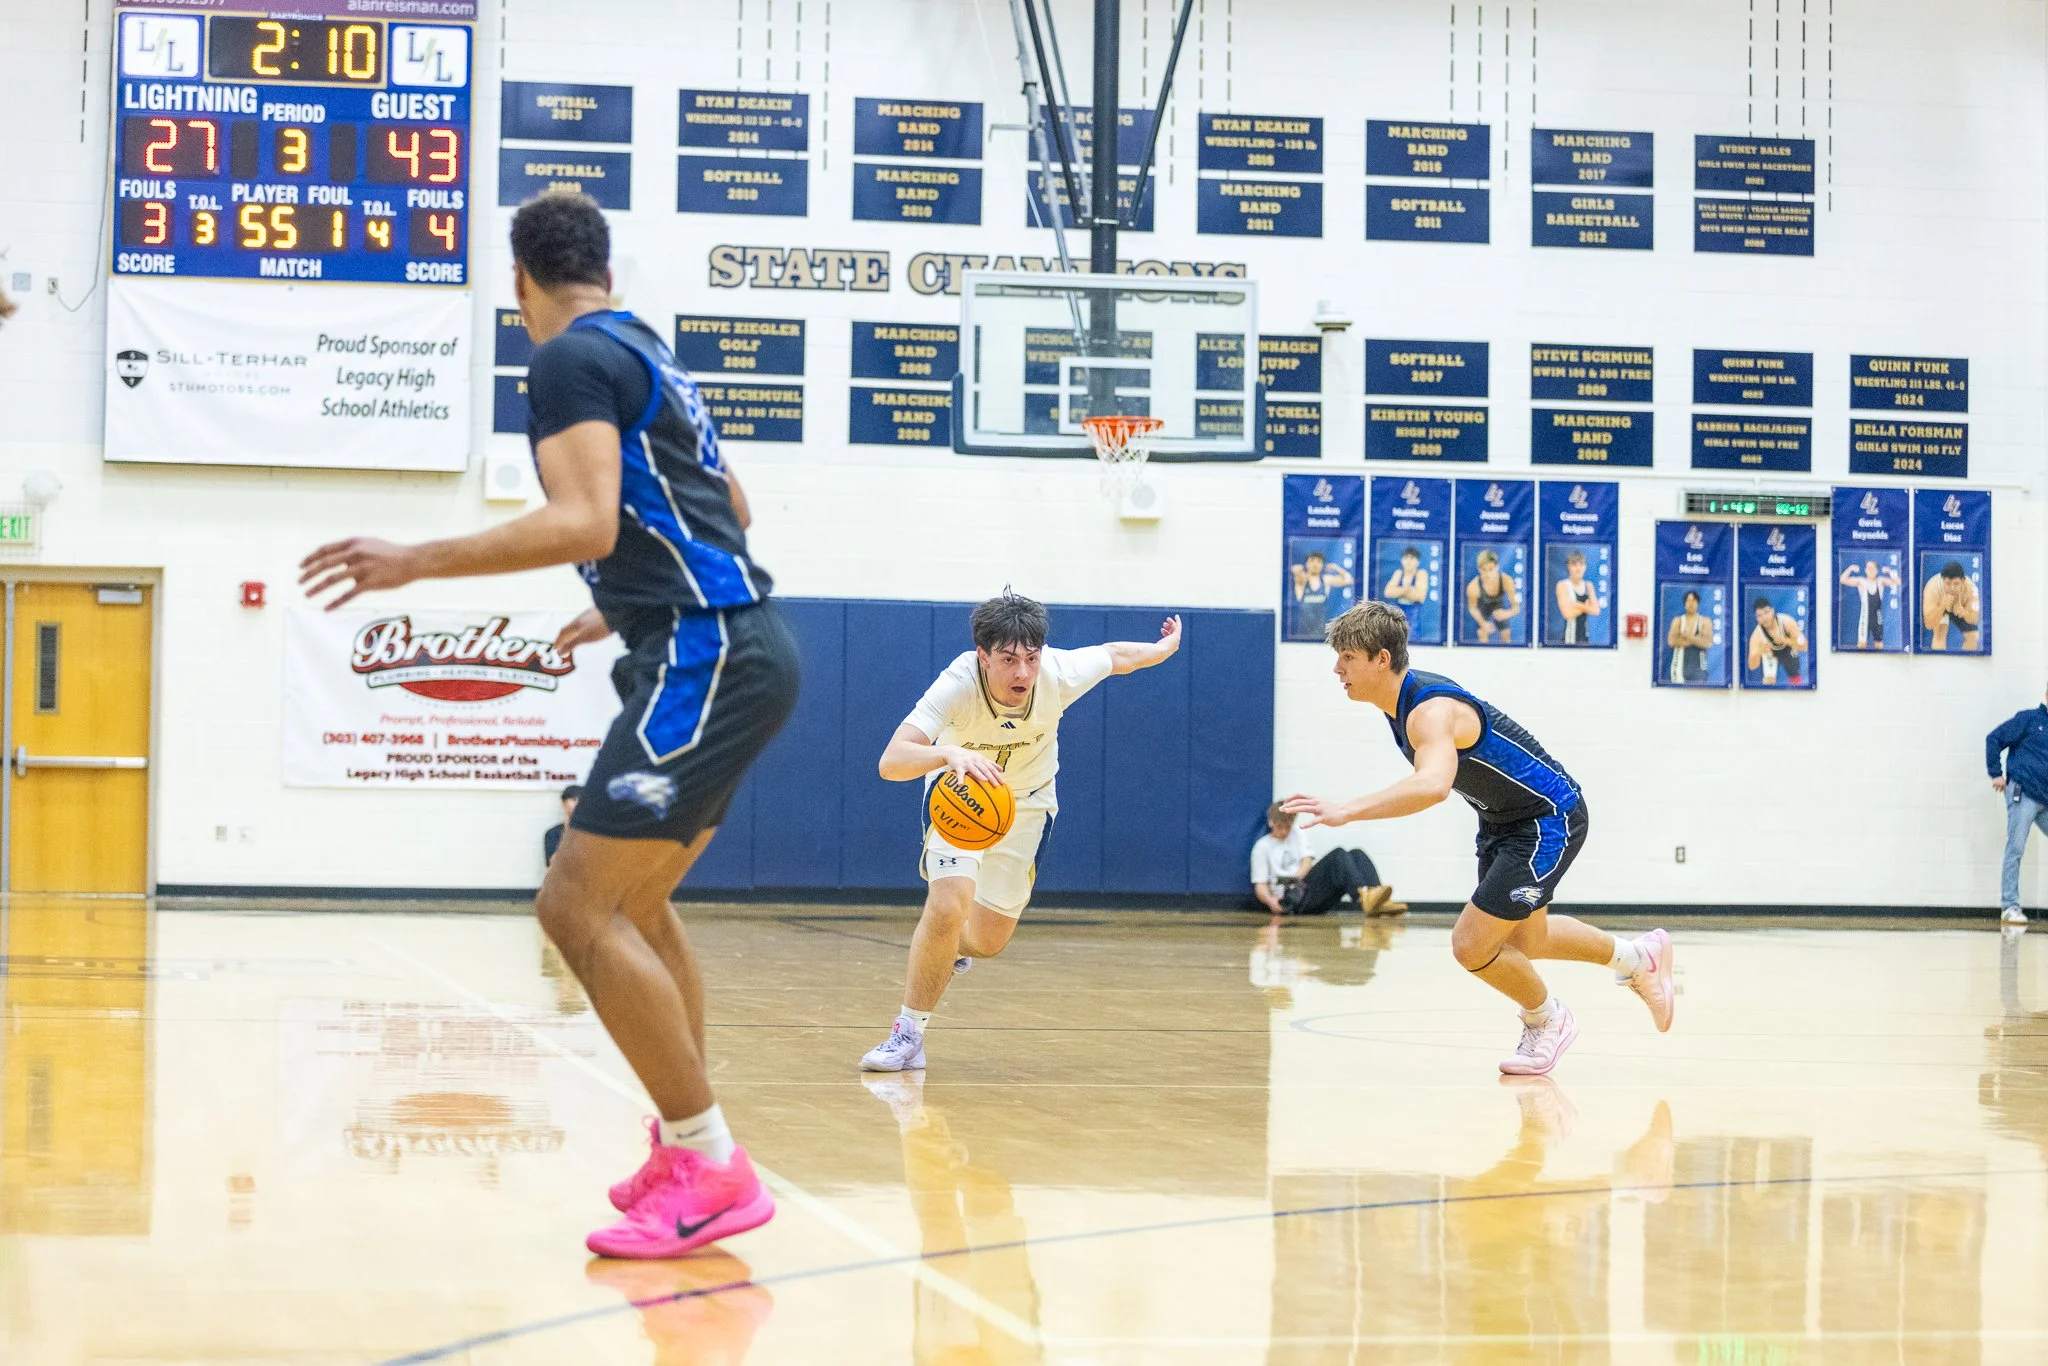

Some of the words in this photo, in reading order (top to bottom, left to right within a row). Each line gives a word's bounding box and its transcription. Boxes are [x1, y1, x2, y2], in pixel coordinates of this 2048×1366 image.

[251, 20, 377, 79] 2:10
[124, 83, 258, 114] LIGHTNING
[536, 95, 598, 109] SOFTBALL
[262, 104, 326, 124] PERIOD
[371, 93, 457, 122] GUEST
[877, 104, 961, 119] MARCHING
[897, 121, 941, 135] BAND
[1212, 118, 1252, 132] RYAN
[1253, 119, 1311, 134] DEAKIN
[1387, 125, 1468, 141] MARCHING
[143, 118, 217, 174] 27
[1552, 133, 1632, 149] MARCHING
[281, 128, 309, 173] 3
[386, 129, 460, 183] 43
[1407, 143, 1449, 157] BAND
[1571, 151, 1613, 165] BAND
[525, 163, 606, 178] SOFTBALL
[703, 169, 783, 185] SOFTBALL
[875, 168, 960, 185] MARCHING
[1577, 167, 1607, 181] 2017
[119, 180, 177, 200] FOULS
[231, 183, 299, 204] PLAYER
[307, 186, 353, 207] FOUL
[895, 186, 940, 201] BAND
[1219, 183, 1301, 199] MARCHING
[188, 194, 223, 211] T.O.L.
[407, 188, 464, 210] FOULS
[1390, 198, 1467, 213] SOFTBALL
[1570, 197, 1615, 211] GIRLS
[362, 201, 397, 217] T.O.L.
[1239, 201, 1282, 215] BAND
[142, 201, 168, 245] 3
[194, 211, 216, 245] 3
[239, 204, 299, 249] 55
[1546, 212, 1640, 228] BASKETBALL
[330, 210, 345, 249] 1
[367, 220, 390, 249] 4
[427, 213, 456, 251] 4
[1578, 230, 1608, 244] 2012
[118, 253, 176, 275] SCORE
[259, 257, 323, 280] MATCH
[708, 244, 891, 293] STATE
[405, 261, 464, 284] SCORE
[680, 319, 731, 334] STEVE
[733, 321, 801, 337] ZIEGLER
[873, 326, 958, 342] MARCHING
[317, 334, 368, 354] Proud
[370, 335, 437, 358] Sponsor
[441, 336, 460, 357] of
[718, 337, 762, 352] GOLF
[894, 343, 938, 359] BAND
[1261, 356, 1301, 371] JUMP
[1389, 352, 1466, 367] SOFTBALL
[1532, 349, 1580, 363] STEVE
[1581, 350, 1652, 365] SCHMUHL
[1721, 357, 1755, 369] QUINN
[1756, 358, 1785, 370] FUNK
[1532, 366, 1566, 378] SWIM
[1620, 369, 1652, 381] FREE
[1868, 358, 1912, 373] QUINN
[1913, 360, 1951, 375] FUNK
[336, 368, 395, 390] Legacy
[397, 368, 437, 391] High
[1853, 375, 1908, 389] WRESTLING
[1894, 392, 1925, 406] 2024
[321, 397, 376, 419] School
[378, 398, 450, 421] Athletics
[892, 409, 937, 424] BAND
[1370, 408, 1431, 422] KIRSTIN
[1433, 409, 1486, 424] YOUNG
[1552, 413, 1633, 429] MARCHING
[1428, 427, 1460, 440] JUMP
[1571, 431, 1614, 445] BAND
[1854, 423, 1897, 437] BELLA
[1899, 424, 1964, 440] FORSMAN
[1855, 440, 1890, 453] GIRLS
[1890, 441, 1922, 455] SWIM
[1941, 444, 1963, 457] FLY
[1892, 457, 1924, 471] 2024
[0, 515, 31, 541] EXIT
[351, 614, 576, 677] Brothers
[446, 733, 602, 750] BrothersPlumbing.com
[386, 753, 433, 765] PROUD
[436, 753, 498, 766] SPONSOR
[501, 754, 516, 766] of
[517, 754, 539, 766] the
[347, 769, 392, 782] Legacy
[395, 769, 426, 782] High
[428, 770, 472, 781] School
[474, 770, 542, 782] Basketball
[544, 771, 578, 782] Team
[943, 773, 986, 818] Wilson
